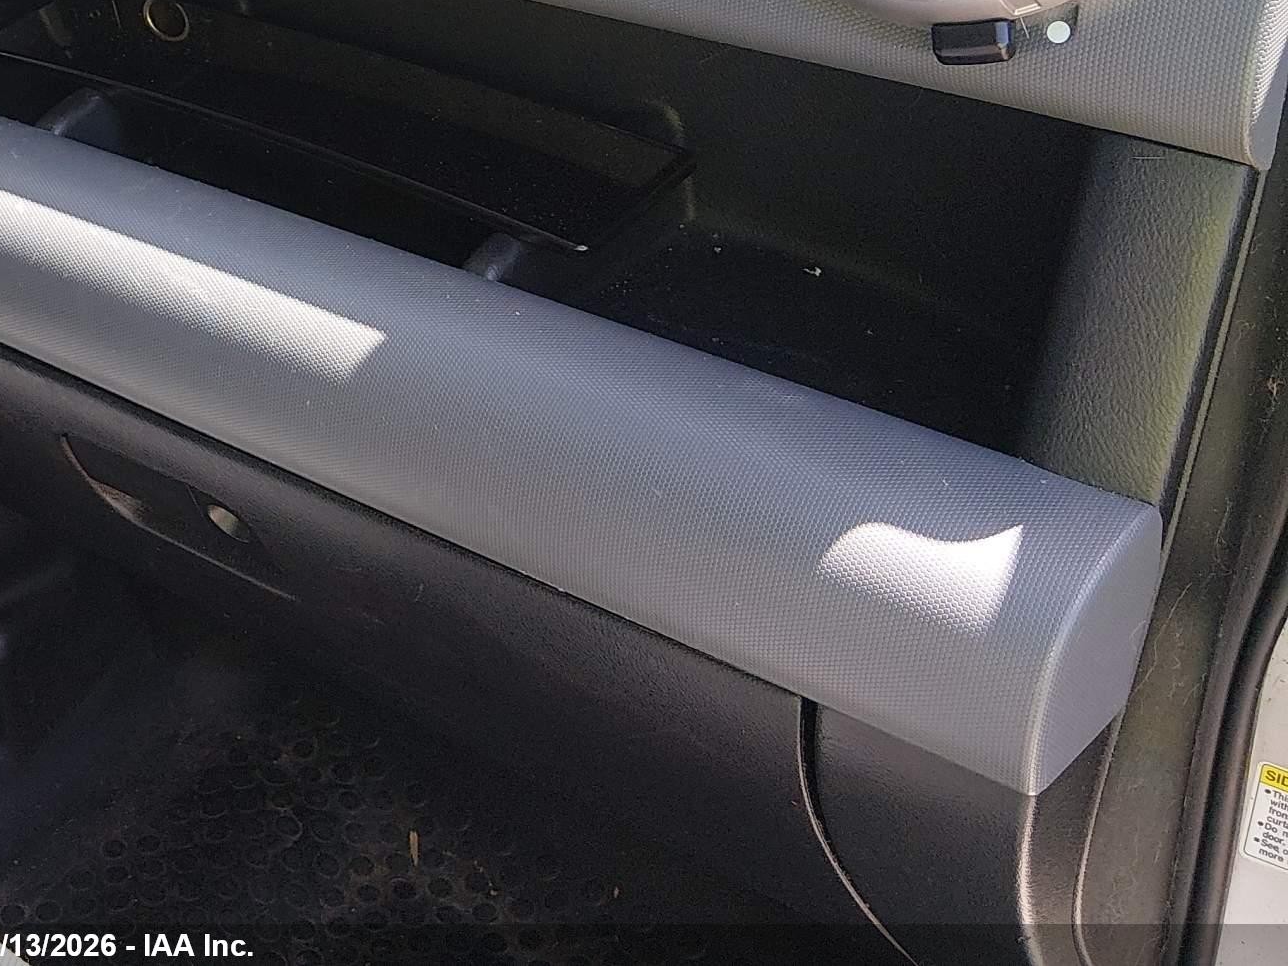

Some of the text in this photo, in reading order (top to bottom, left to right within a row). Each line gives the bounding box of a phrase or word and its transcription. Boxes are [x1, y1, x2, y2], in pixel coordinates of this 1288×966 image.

[1264, 822, 1278, 834] Do
[1262, 831, 1286, 847] door.
[1258, 848, 1284, 863] more
